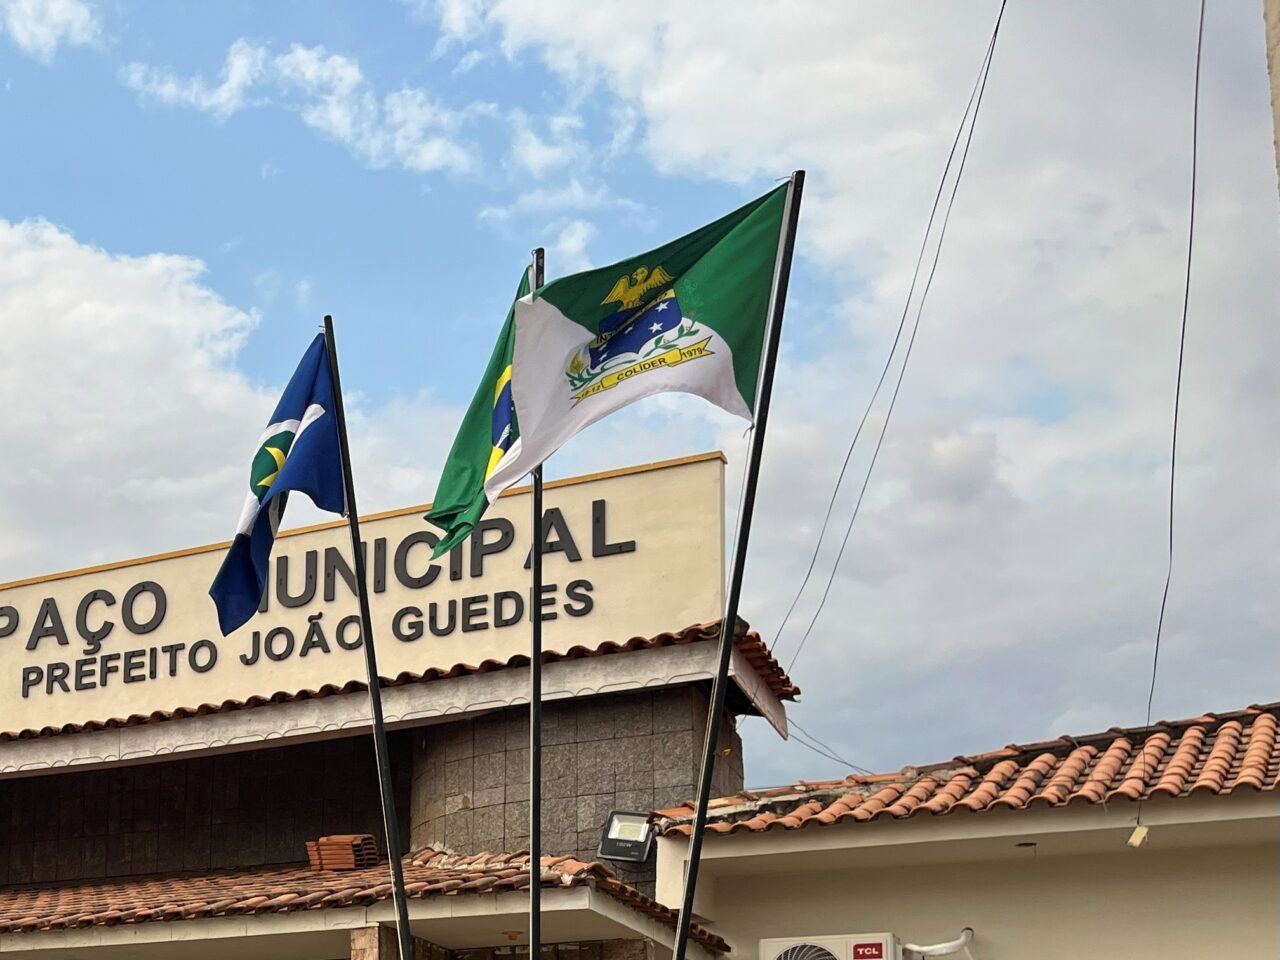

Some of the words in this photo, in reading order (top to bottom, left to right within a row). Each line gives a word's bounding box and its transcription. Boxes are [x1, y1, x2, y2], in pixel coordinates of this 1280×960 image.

[682, 346, 704, 360] 1979
[258, 499, 636, 614] UNICIPAL
[22, 640, 218, 699] PREFEITO
[239, 612, 364, 666] JOÃO
[392, 580, 594, 642] GUEDES
[857, 947, 879, 955] TCL
